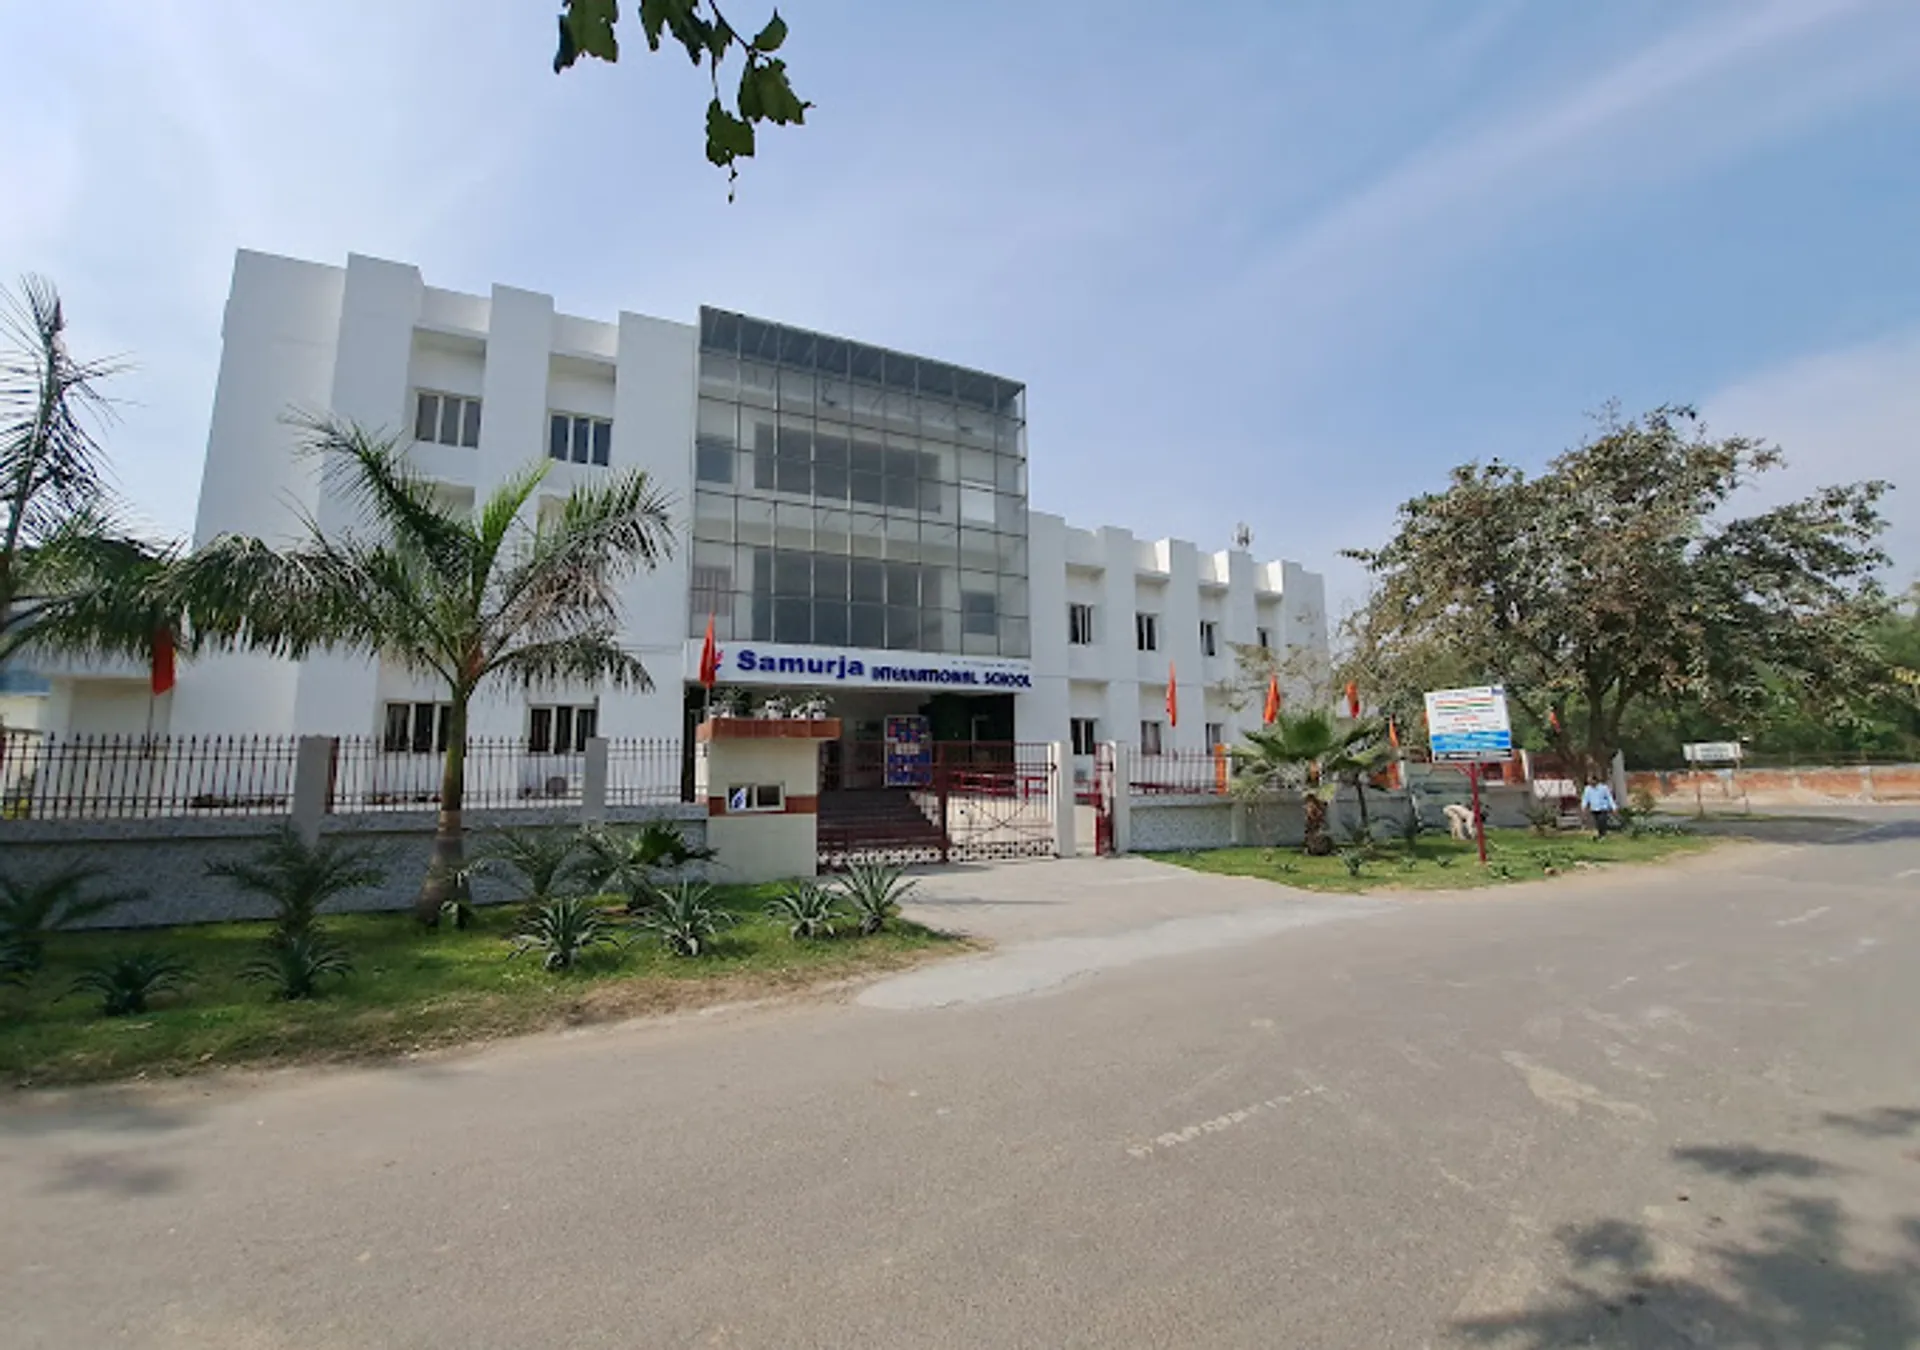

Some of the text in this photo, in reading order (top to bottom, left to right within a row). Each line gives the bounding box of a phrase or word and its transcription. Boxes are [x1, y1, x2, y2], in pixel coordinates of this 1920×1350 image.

[737, 650, 865, 680] Samurja
[872, 665, 978, 685] INTERNATIONAL
[984, 671, 1032, 688] SCHOOL
